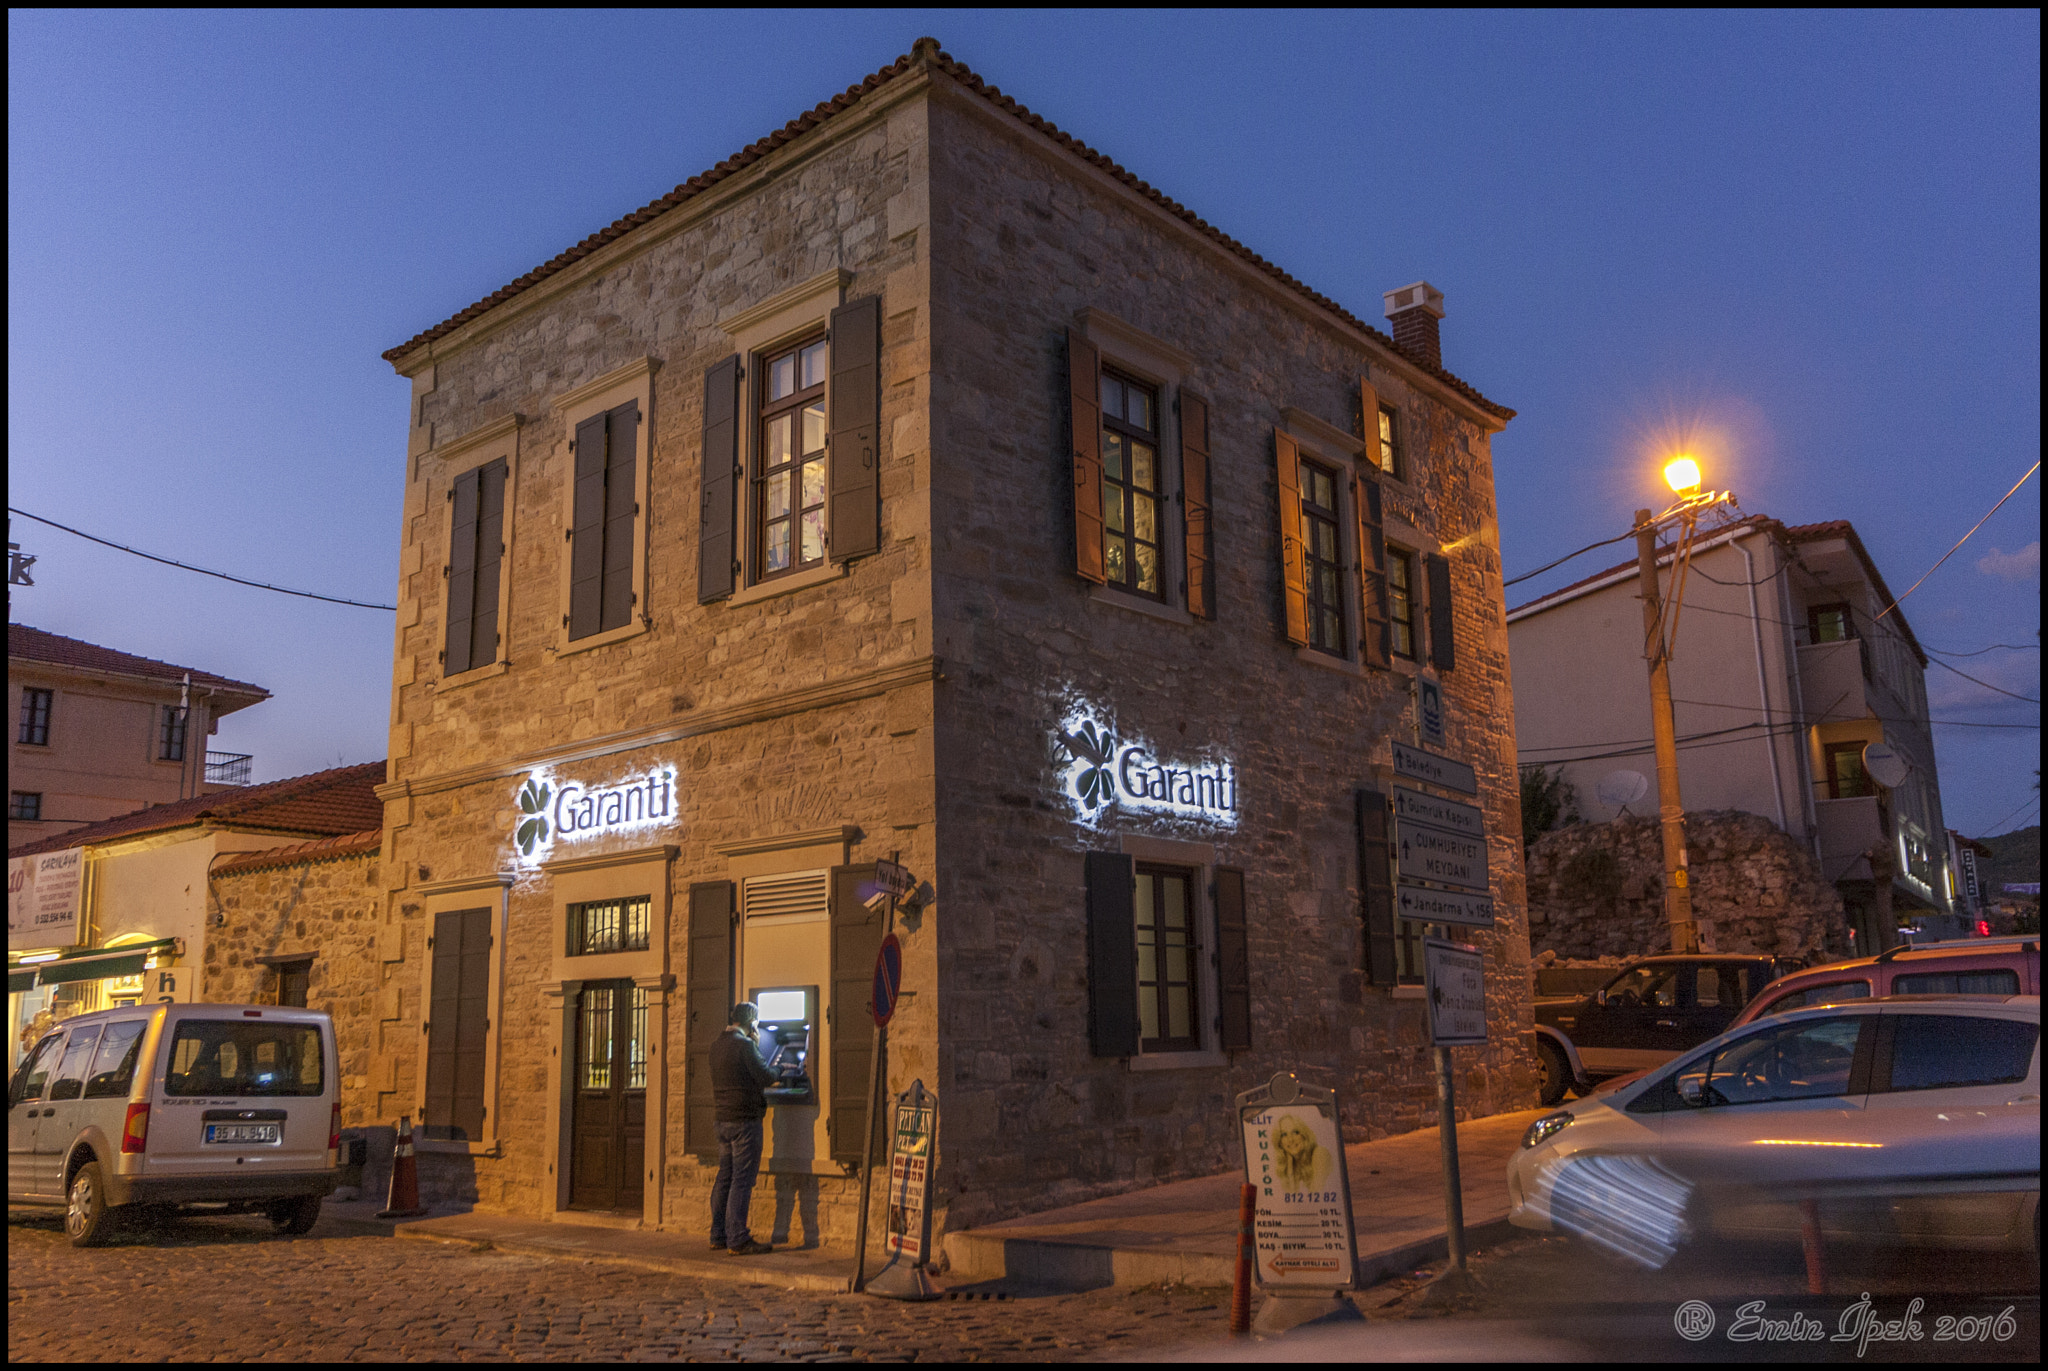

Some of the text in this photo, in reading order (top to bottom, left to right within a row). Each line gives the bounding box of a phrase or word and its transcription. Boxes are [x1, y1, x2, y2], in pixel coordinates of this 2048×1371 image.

[1406, 754, 1442, 779] Belediye
[1119, 747, 1236, 812] Garanti
[555, 771, 671, 833] Garanti
[1427, 858, 1470, 880] MEYDANI
[1414, 896, 1491, 919] Jandarma 156
[216, 1127, 229, 1140] 35
[234, 1127, 246, 1140] AL
[1258, 1129, 1274, 1197] KUAFÖR
[1284, 1192, 1337, 1203] 812 12 82
